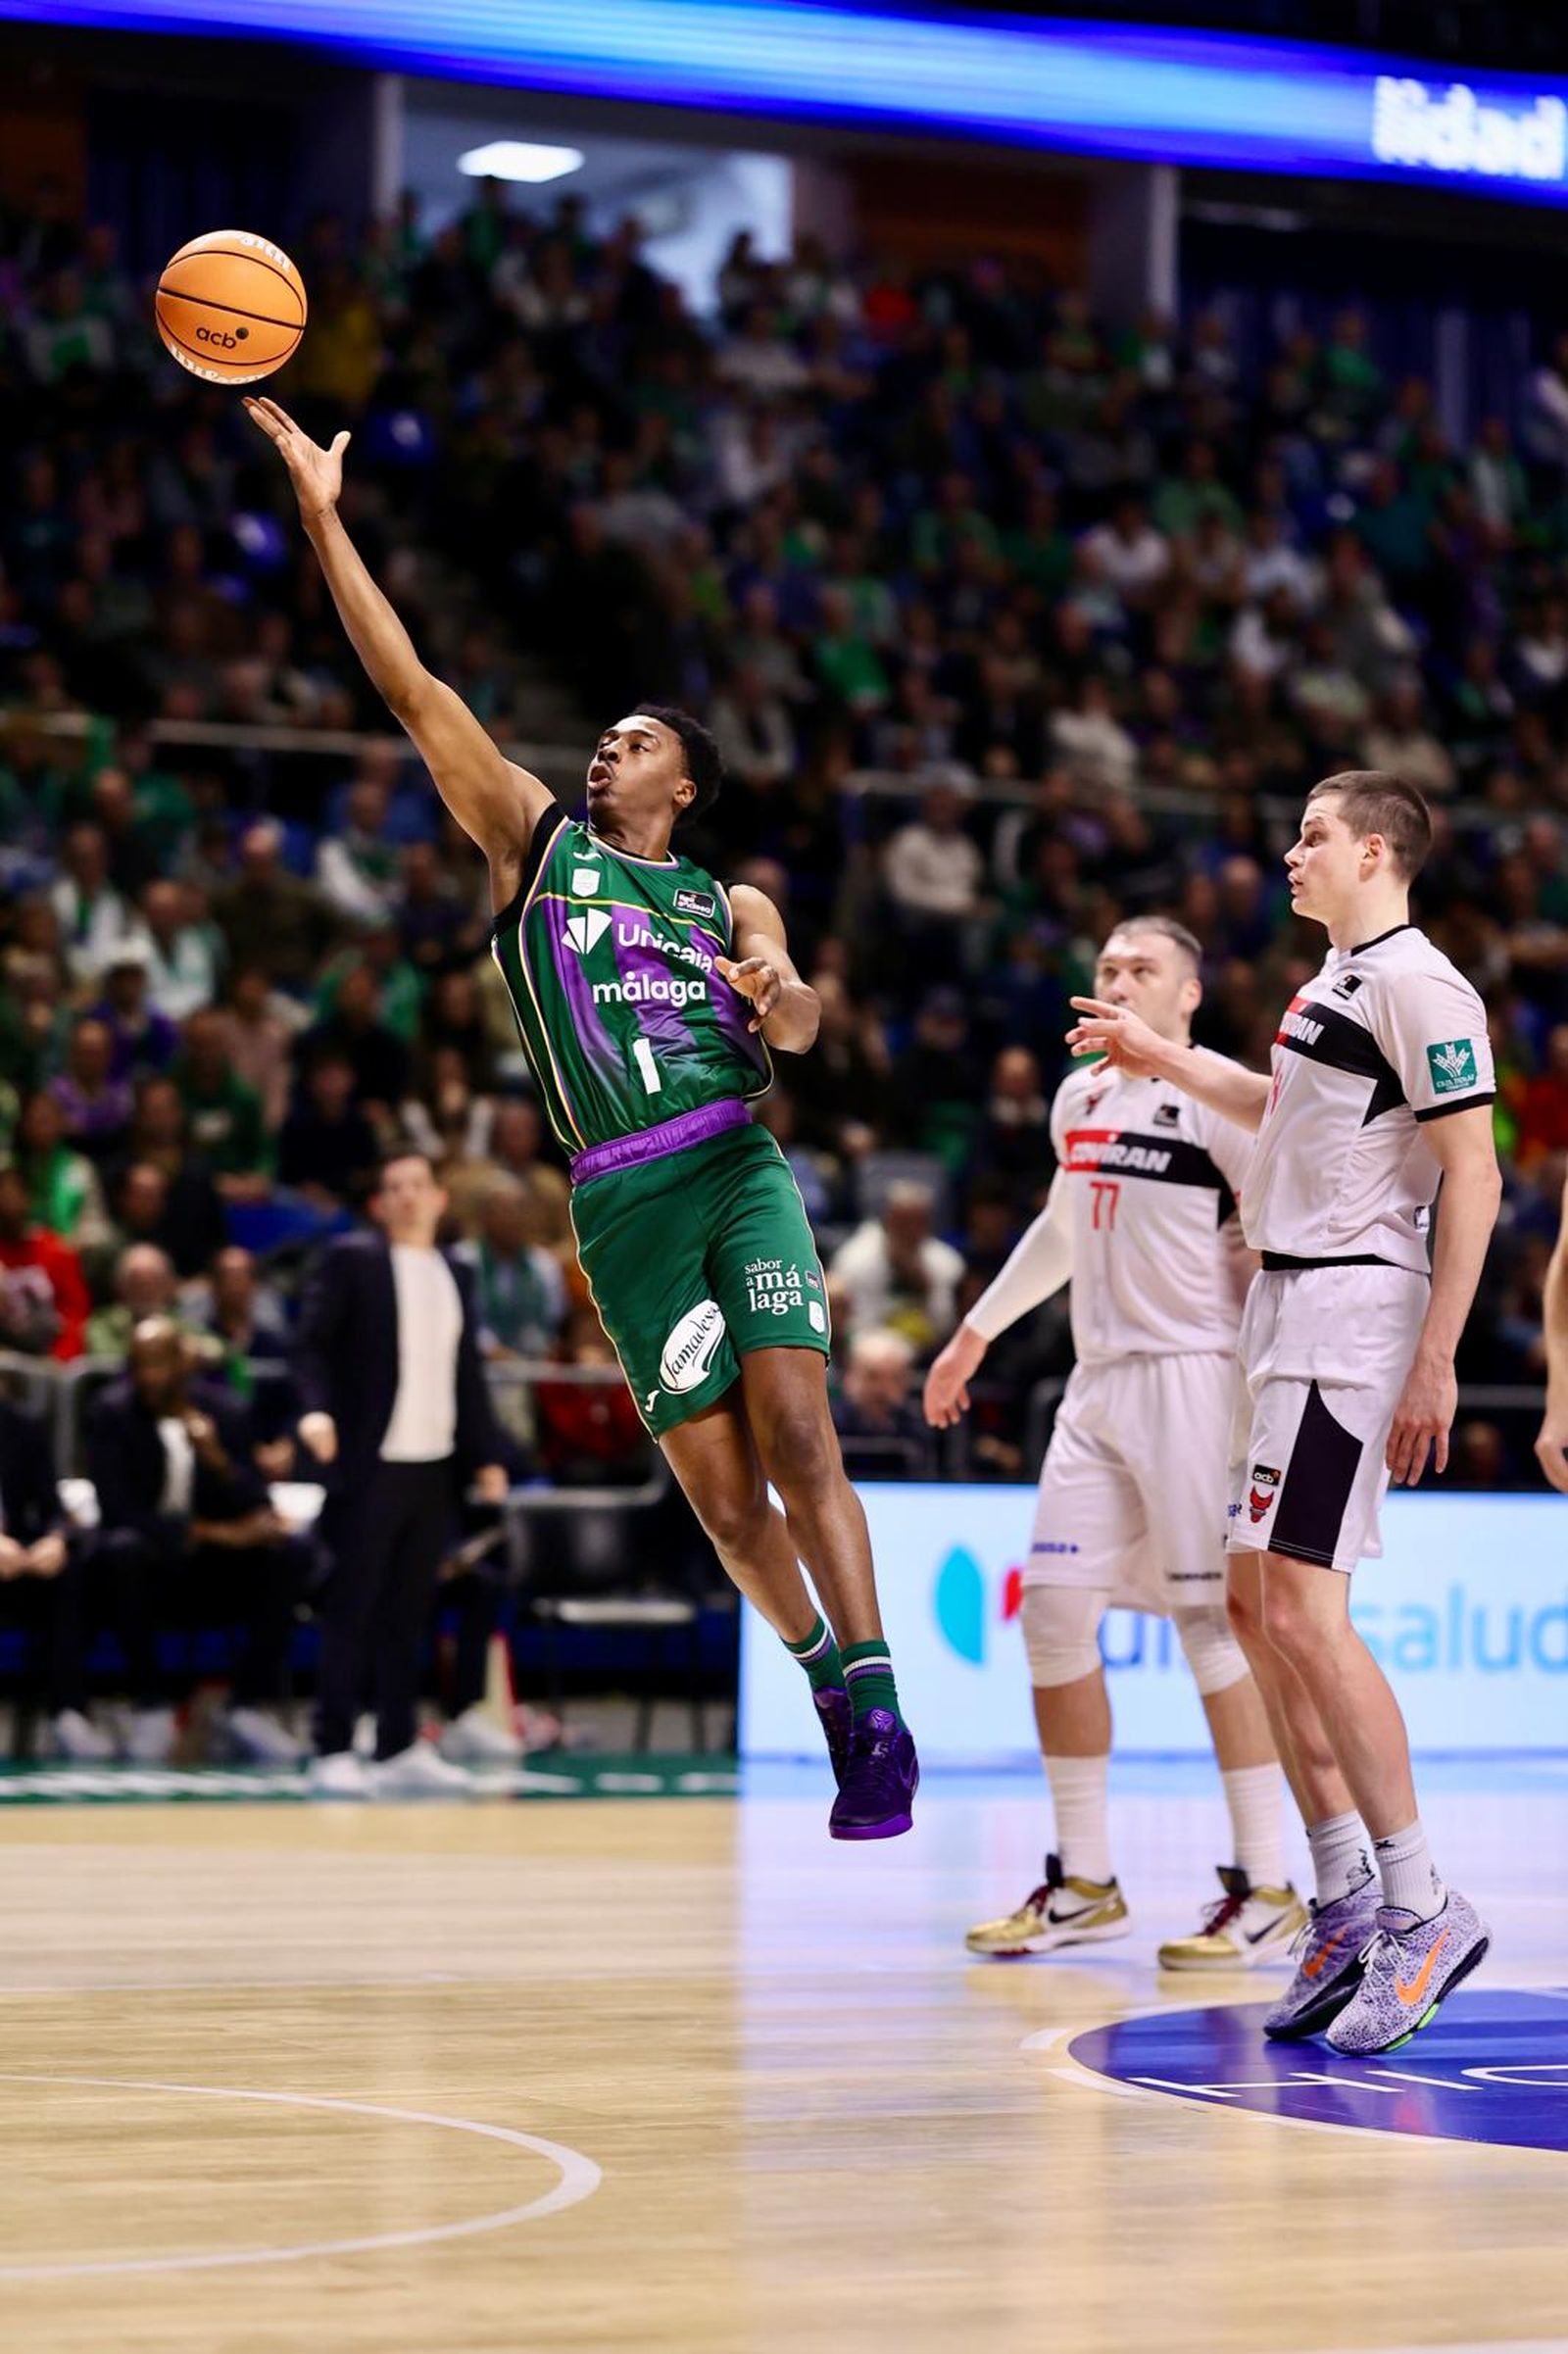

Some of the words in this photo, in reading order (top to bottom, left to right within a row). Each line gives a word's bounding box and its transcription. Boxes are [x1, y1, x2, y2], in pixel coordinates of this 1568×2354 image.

[196, 326, 237, 350] acb
[632, 1037, 662, 1096] 1
[1090, 1181, 1120, 1232] 77
[745, 1257, 783, 1275] sabor
[746, 1276, 755, 1288] a
[755, 1263, 804, 1291] má
[748, 1288, 805, 1315] laga
